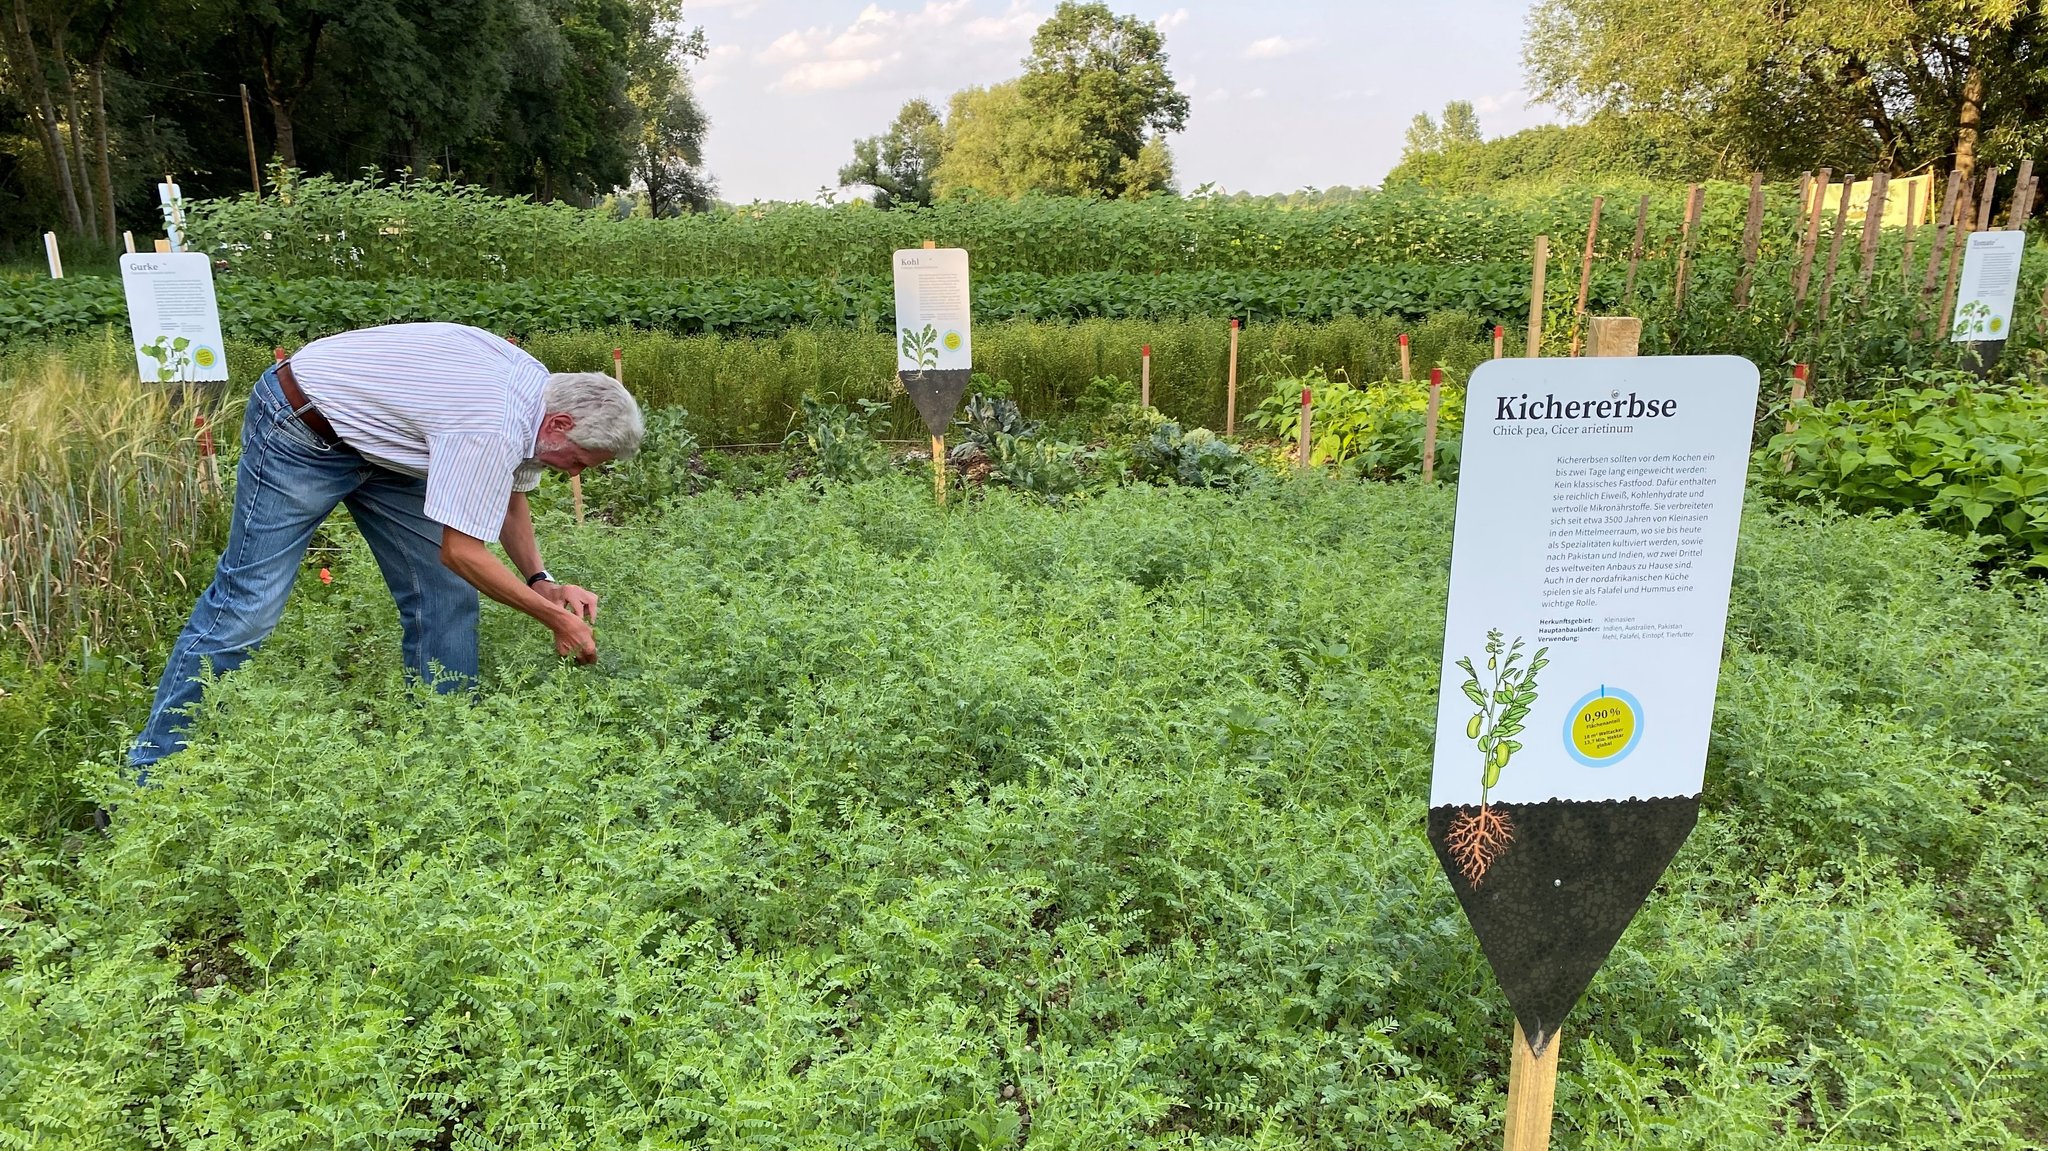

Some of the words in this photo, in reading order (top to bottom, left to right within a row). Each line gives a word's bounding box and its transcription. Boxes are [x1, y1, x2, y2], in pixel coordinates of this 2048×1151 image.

[130, 262, 158, 271] Gurke
[901, 258, 920, 266] Kohl
[1494, 392, 1677, 420] Kichererbse
[1493, 425, 1523, 435] Chick
[1526, 427, 1548, 438] pea,
[1551, 424, 1579, 435] Cicer
[1581, 423, 1633, 434] arietinum
[1557, 456, 1608, 464] Kichererbsen
[1610, 455, 1637, 463] sollten
[1672, 454, 1701, 462] Kochen
[1589, 468, 1606, 477] Tage
[1608, 468, 1625, 477] lang
[1627, 467, 1674, 476] eingeweicht
[1675, 466, 1707, 474] werden:
[1554, 481, 1571, 489] Kein
[1573, 480, 1617, 488] klassisches
[1619, 479, 1655, 487] Fastfood.
[1656, 478, 1677, 486] Dafür
[1679, 478, 1717, 486] enthalten
[1553, 493, 1564, 501] sie
[1566, 492, 1599, 500] reichlich
[1601, 491, 1629, 500] Eiweiß,
[1631, 490, 1687, 500] Kohlenhydrate
[1689, 490, 1704, 498] und
[1551, 505, 1588, 513] wertvolle
[1590, 503, 1652, 512] Mikronährstoffe.
[1654, 503, 1665, 511] Sie
[1667, 502, 1713, 510] verbreiteten
[1550, 517, 1566, 525] sich
[1604, 516, 1623, 524] 3500
[1624, 515, 1651, 523] Jahren
[1668, 514, 1708, 522] Kleinasien
[1549, 529, 1557, 537] in
[1558, 529, 1573, 537] den
[1575, 527, 1639, 536] Mittelmeerraum,
[1666, 526, 1678, 534] bis
[1548, 541, 1559, 549] als
[1612, 539, 1647, 547] kultiviert
[1648, 538, 1679, 547] werden,
[1681, 538, 1703, 546] sowie
[1546, 553, 1566, 561] nach
[1567, 552, 1600, 560] Pakistan
[1601, 551, 1617, 559] und
[1619, 550, 1645, 560] Indien,
[1679, 549, 1703, 557] Drittel
[1545, 565, 1559, 573] des
[1561, 564, 1605, 572] weltweiten
[1606, 563, 1636, 571] Anbaus
[1648, 562, 1673, 570] Hause
[1674, 561, 1693, 569] sind.
[1544, 576, 1564, 585] Auch
[1566, 576, 1573, 584] in
[1575, 575, 1589, 583] der
[1590, 574, 1663, 583] nordafrikanischen
[1664, 573, 1689, 581] Küche
[1543, 588, 1571, 597] spielen
[1584, 587, 1596, 595] als
[1597, 586, 1623, 594] Falafel
[1624, 585, 1639, 593] und
[1641, 585, 1675, 593] Hummus
[1677, 584, 1693, 592] eine
[1542, 599, 1574, 609] wichtige
[1576, 598, 1597, 606] Rolle.
[1539, 626, 1600, 634] Hauptanbauländer:
[1603, 624, 1624, 632] Indien,
[1537, 635, 1580, 643] Verwendung:
[1584, 710, 1608, 722] 0,90
[1610, 707, 1621, 715] %
